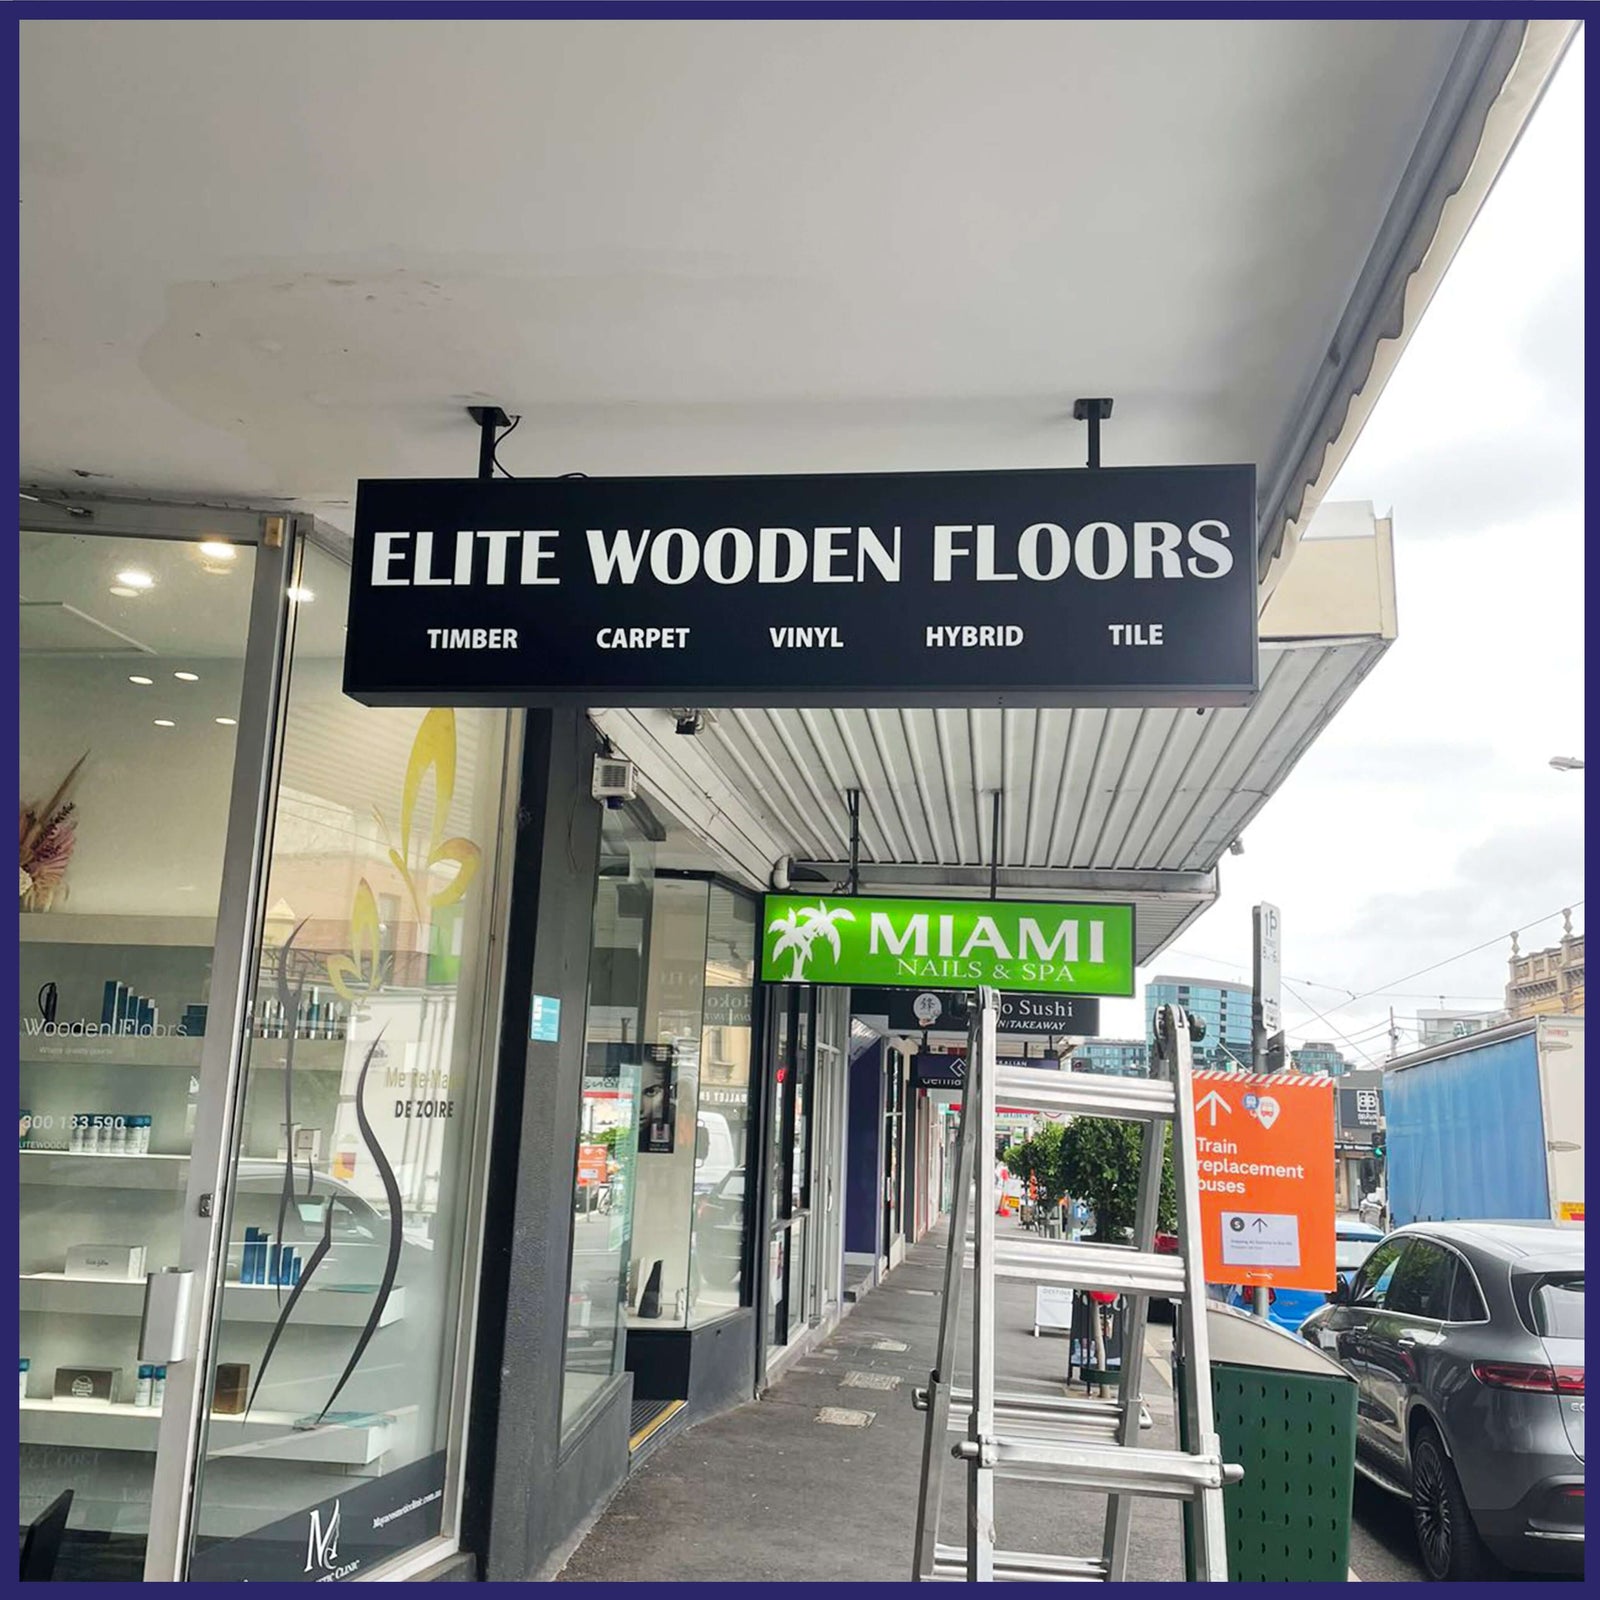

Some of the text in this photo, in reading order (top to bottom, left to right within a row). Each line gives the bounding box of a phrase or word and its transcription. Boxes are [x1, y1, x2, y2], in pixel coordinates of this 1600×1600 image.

[372, 520, 1234, 586] ELITE WOODEN FLOORS
[427, 625, 1164, 649] TIMBER CARPET VINYL HYBRID TILE
[869, 912, 1104, 963] MIAMI
[897, 958, 1075, 982] NAILS & SPA
[1019, 1000, 1073, 1017] Sushi
[24, 1018, 188, 1038] Wooden Floors
[998, 1020, 1066, 1030] N/TAKEAWAY
[394, 1100, 454, 1118] DE ZOIRE
[22, 1115, 54, 1130] 300
[93, 1116, 125, 1130] 590
[1197, 1137, 1238, 1155] Train
[1197, 1158, 1305, 1180] replacement
